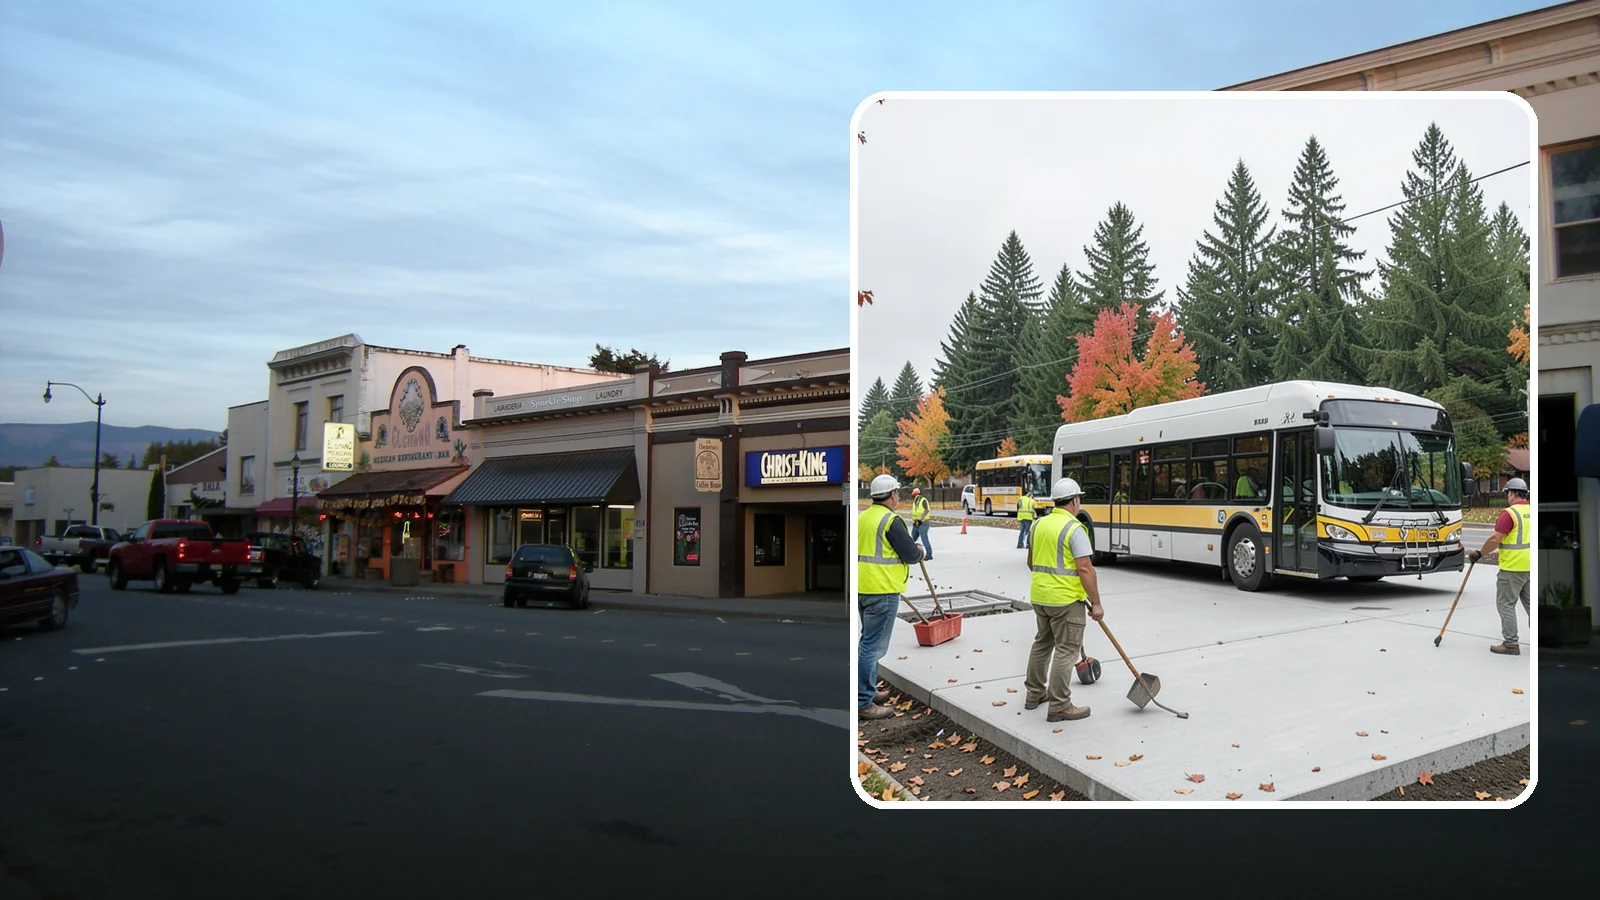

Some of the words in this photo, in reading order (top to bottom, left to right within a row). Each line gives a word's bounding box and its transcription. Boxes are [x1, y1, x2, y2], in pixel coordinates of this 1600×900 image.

[595, 388, 624, 400] LAUNDRY
[493, 402, 523, 412] LAVANDERIA
[530, 398, 561, 409] Sparkle
[562, 394, 582, 405] Shop
[373, 454, 396, 464] MEXICAN
[397, 451, 433, 462] RESTAURANT
[438, 450, 450, 459] BAR
